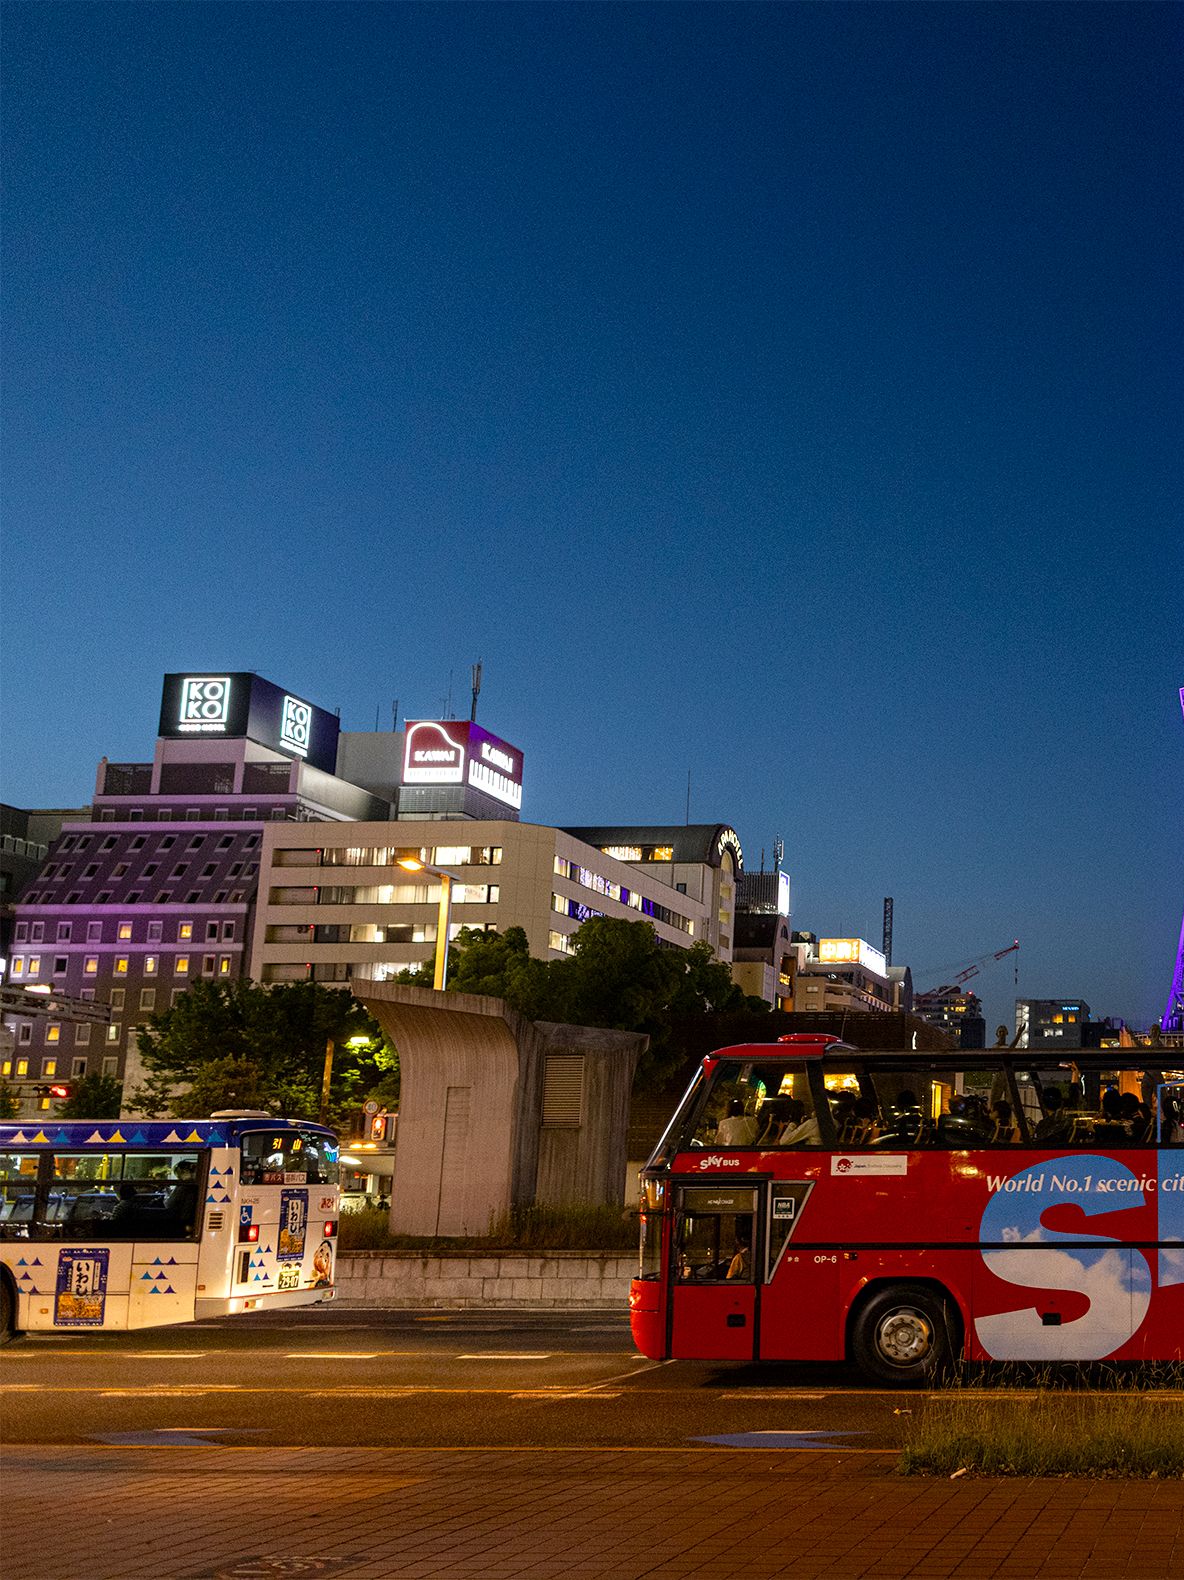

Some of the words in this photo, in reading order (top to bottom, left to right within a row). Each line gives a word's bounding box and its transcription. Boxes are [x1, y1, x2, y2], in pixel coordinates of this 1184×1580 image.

[414, 750, 456, 762] KAWAI
[481, 742, 513, 774] KAWAI
[272, 1138, 302, 1150] 引山
[700, 1155, 723, 1170] SKY
[986, 1173, 1045, 1193] World
[1050, 1175, 1092, 1193] No.1
[1096, 1173, 1157, 1193] scenic
[290, 1201, 299, 1233] いわし
[814, 1255, 837, 1264] OP-6
[76, 1262, 90, 1296] いわし
